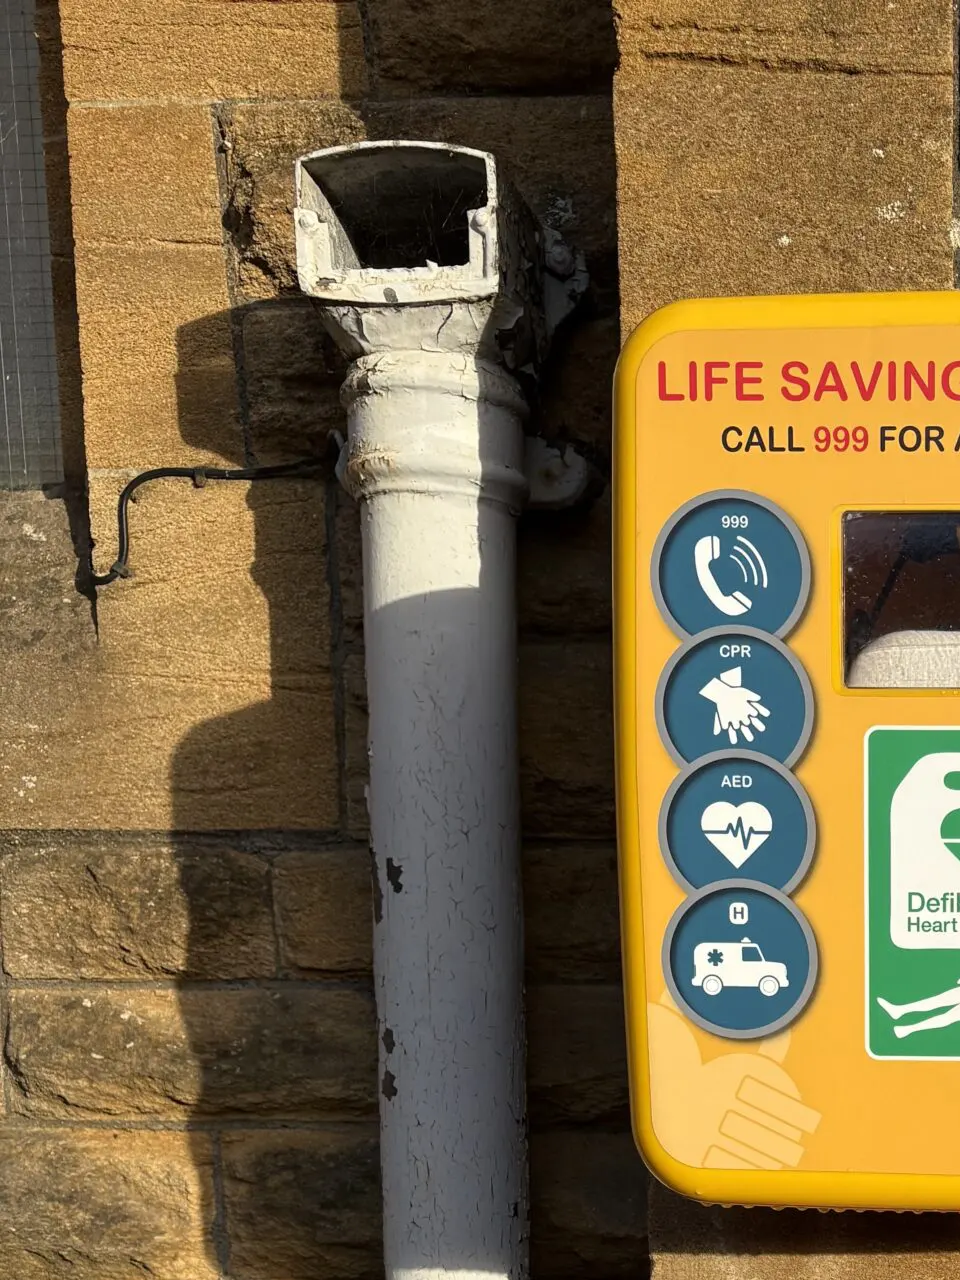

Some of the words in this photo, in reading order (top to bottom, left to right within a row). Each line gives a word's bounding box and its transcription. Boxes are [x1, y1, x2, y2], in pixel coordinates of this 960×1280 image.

[658, 361, 764, 401] LIFE
[722, 426, 805, 452] CALL
[814, 426, 868, 452] 999
[880, 426, 944, 452] FOR
[721, 516, 749, 529] 999
[719, 645, 751, 658] CPR
[720, 775, 753, 788] AED
[733, 907, 745, 920] H
[908, 917, 957, 932] Heart
